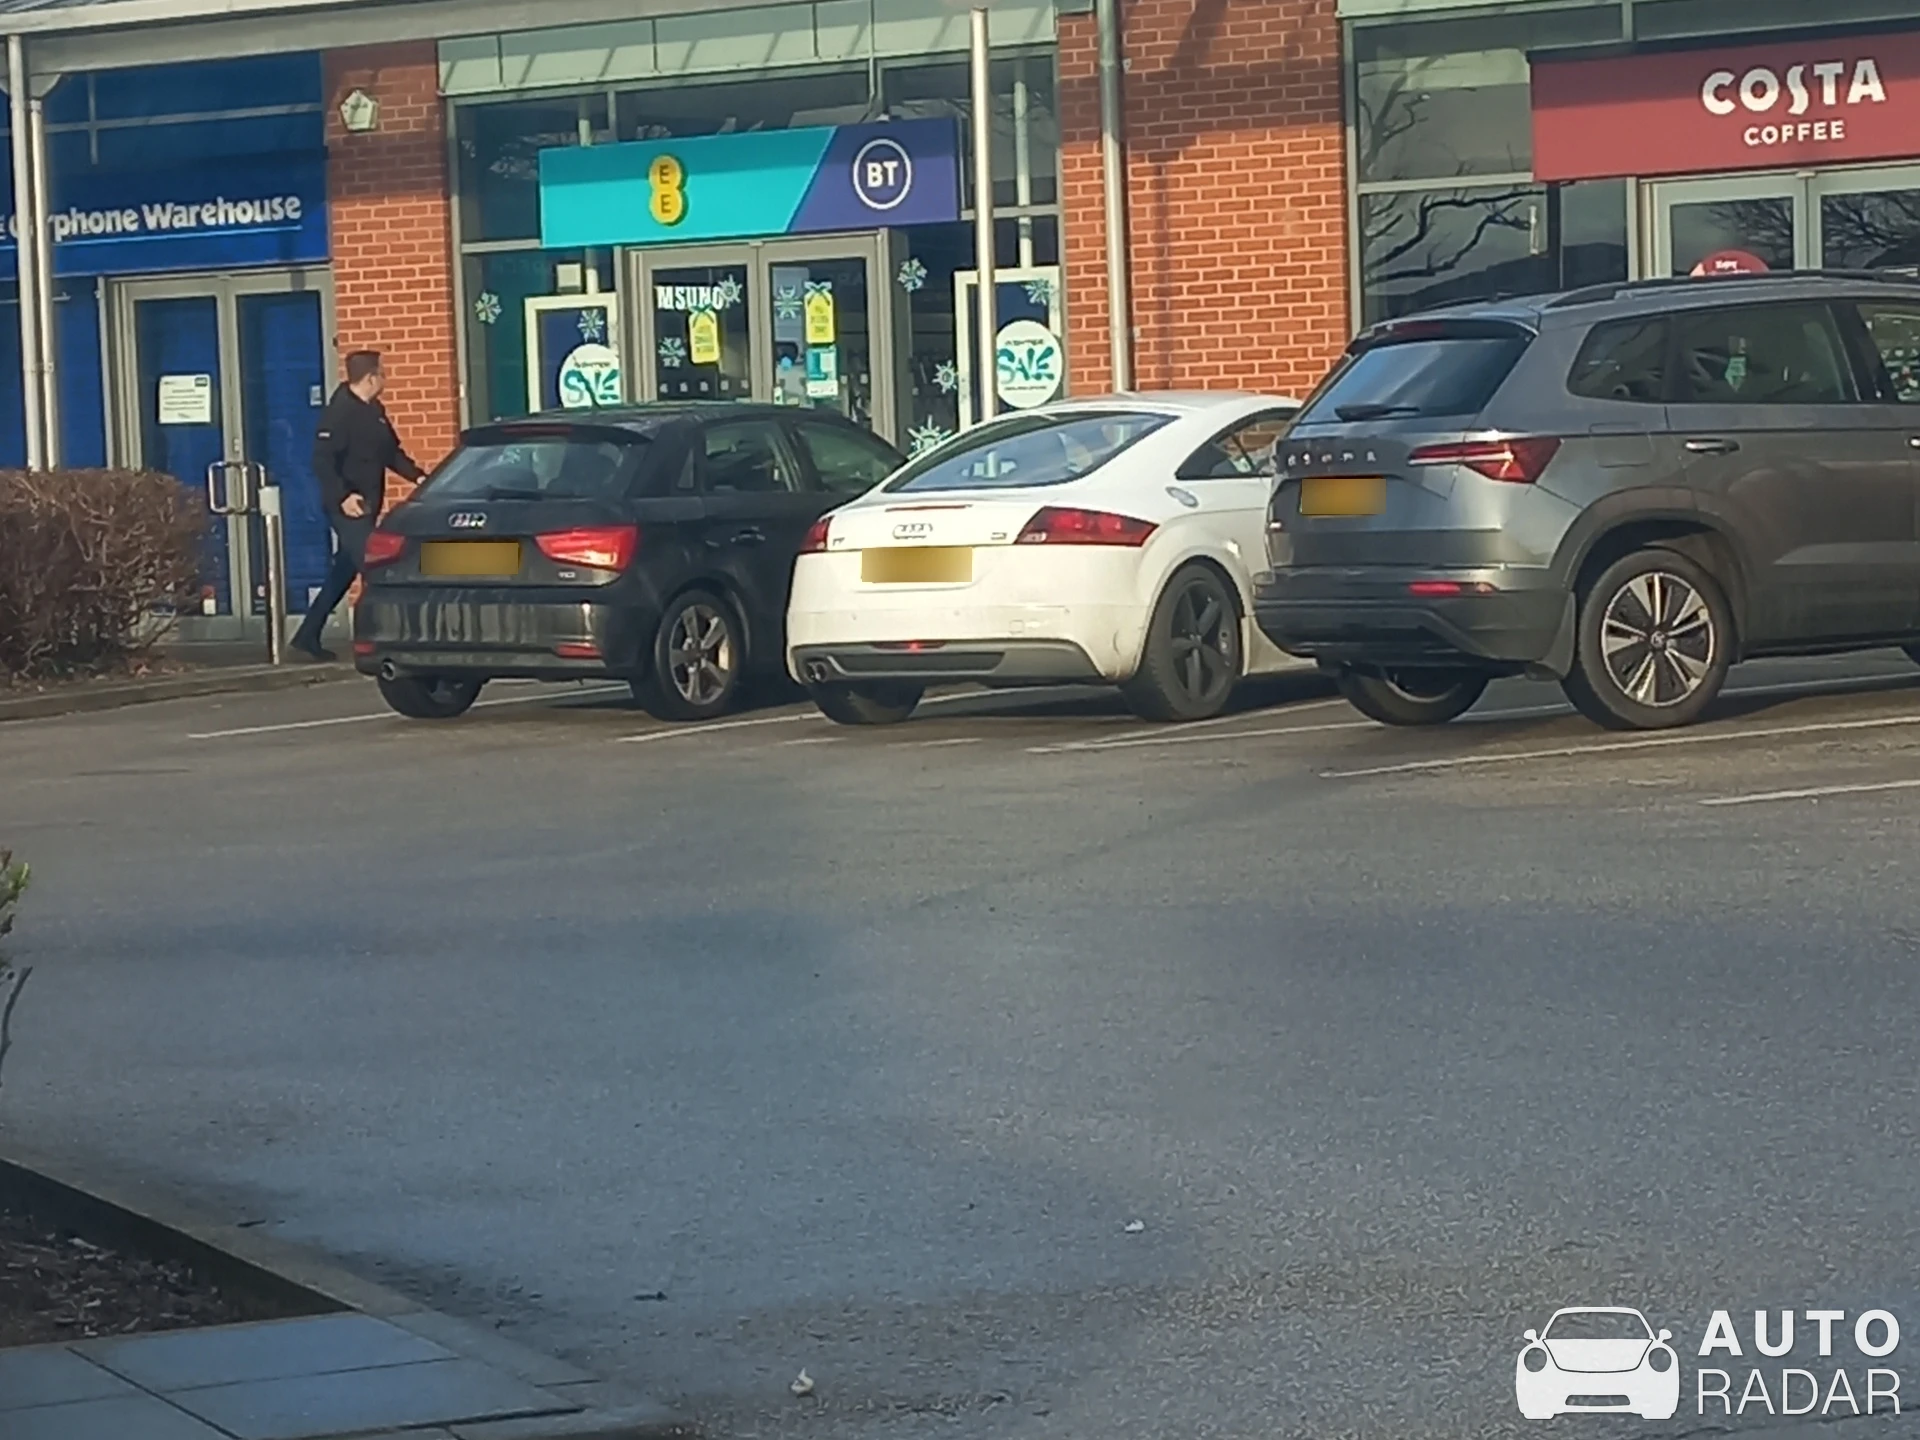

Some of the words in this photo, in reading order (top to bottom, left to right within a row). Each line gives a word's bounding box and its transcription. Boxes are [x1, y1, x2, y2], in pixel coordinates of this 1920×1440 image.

[1701, 59, 1887, 115] COSTA
[1743, 120, 1845, 146] COFFEE
[866, 161, 899, 188] BT
[9, 206, 139, 242] Cphone
[142, 196, 302, 232] Warehouse
